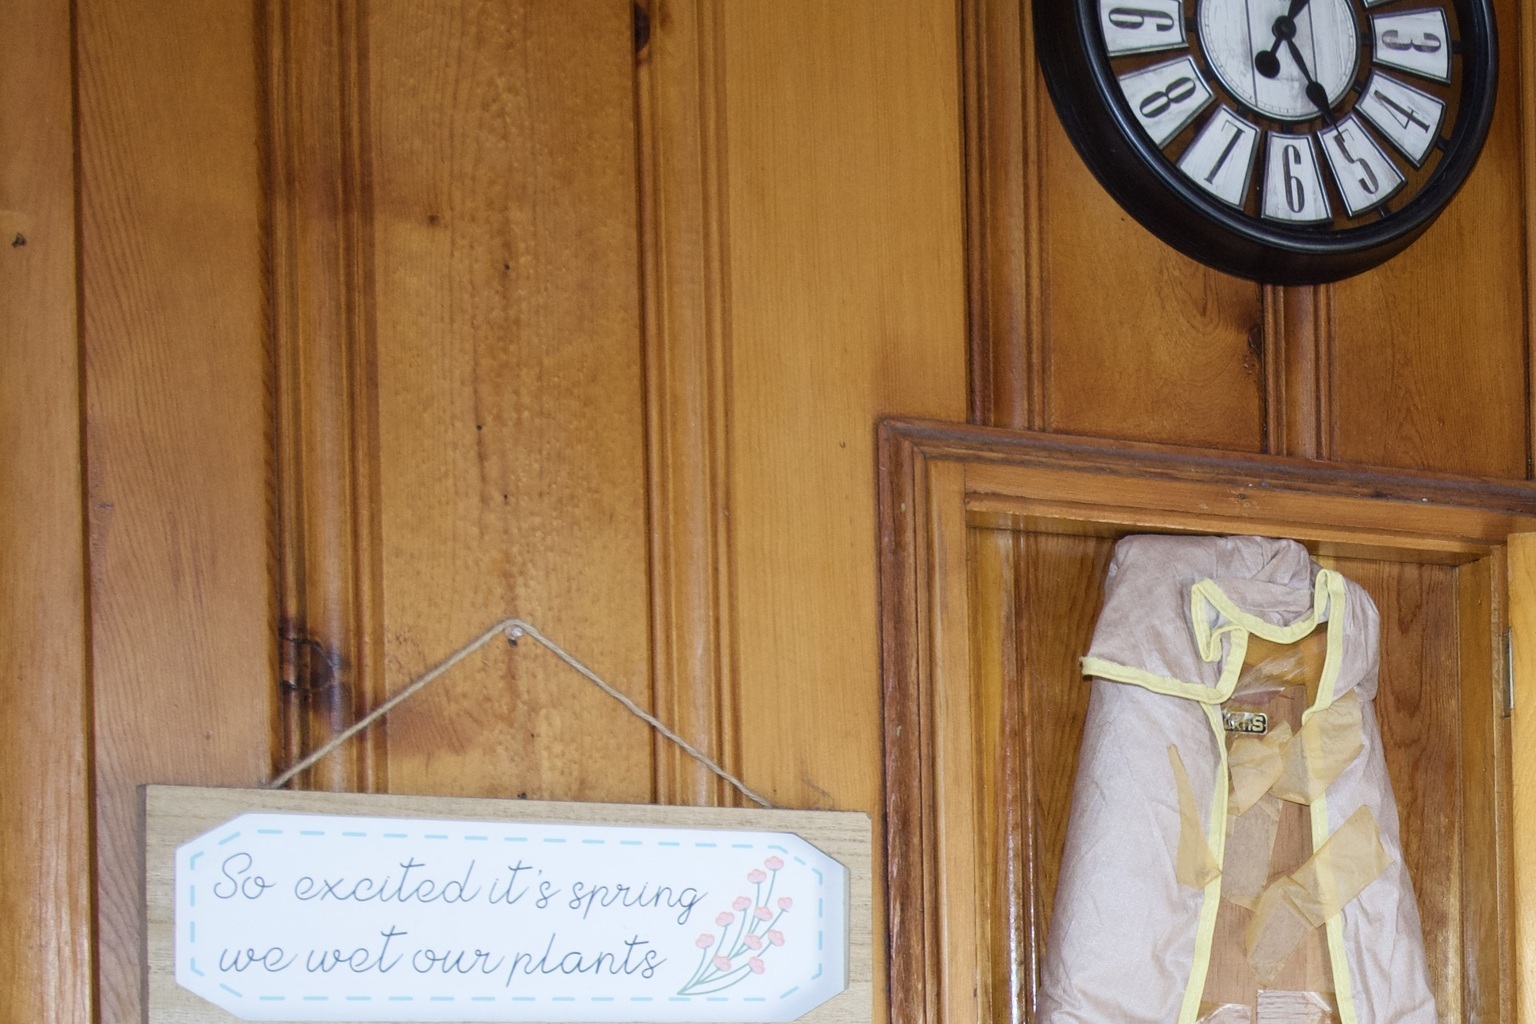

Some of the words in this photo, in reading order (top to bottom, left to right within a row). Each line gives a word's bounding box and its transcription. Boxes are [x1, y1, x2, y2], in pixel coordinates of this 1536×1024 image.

[1108, 8, 1174, 32] 9
[1382, 29, 1442, 54] 3
[1140, 76, 1196, 119] 8
[1373, 89, 1430, 134] 4
[1204, 119, 1246, 185] 7
[1281, 144, 1305, 213] 6
[1333, 128, 1379, 195] 5
[213, 852, 277, 900] So
[294, 856, 482, 904] excited
[488, 860, 562, 910] it's
[568, 880, 709, 926] spring
[219, 946, 298, 973] we
[306, 924, 408, 974] wet
[412, 948, 505, 974] our
[505, 932, 668, 988] plants
